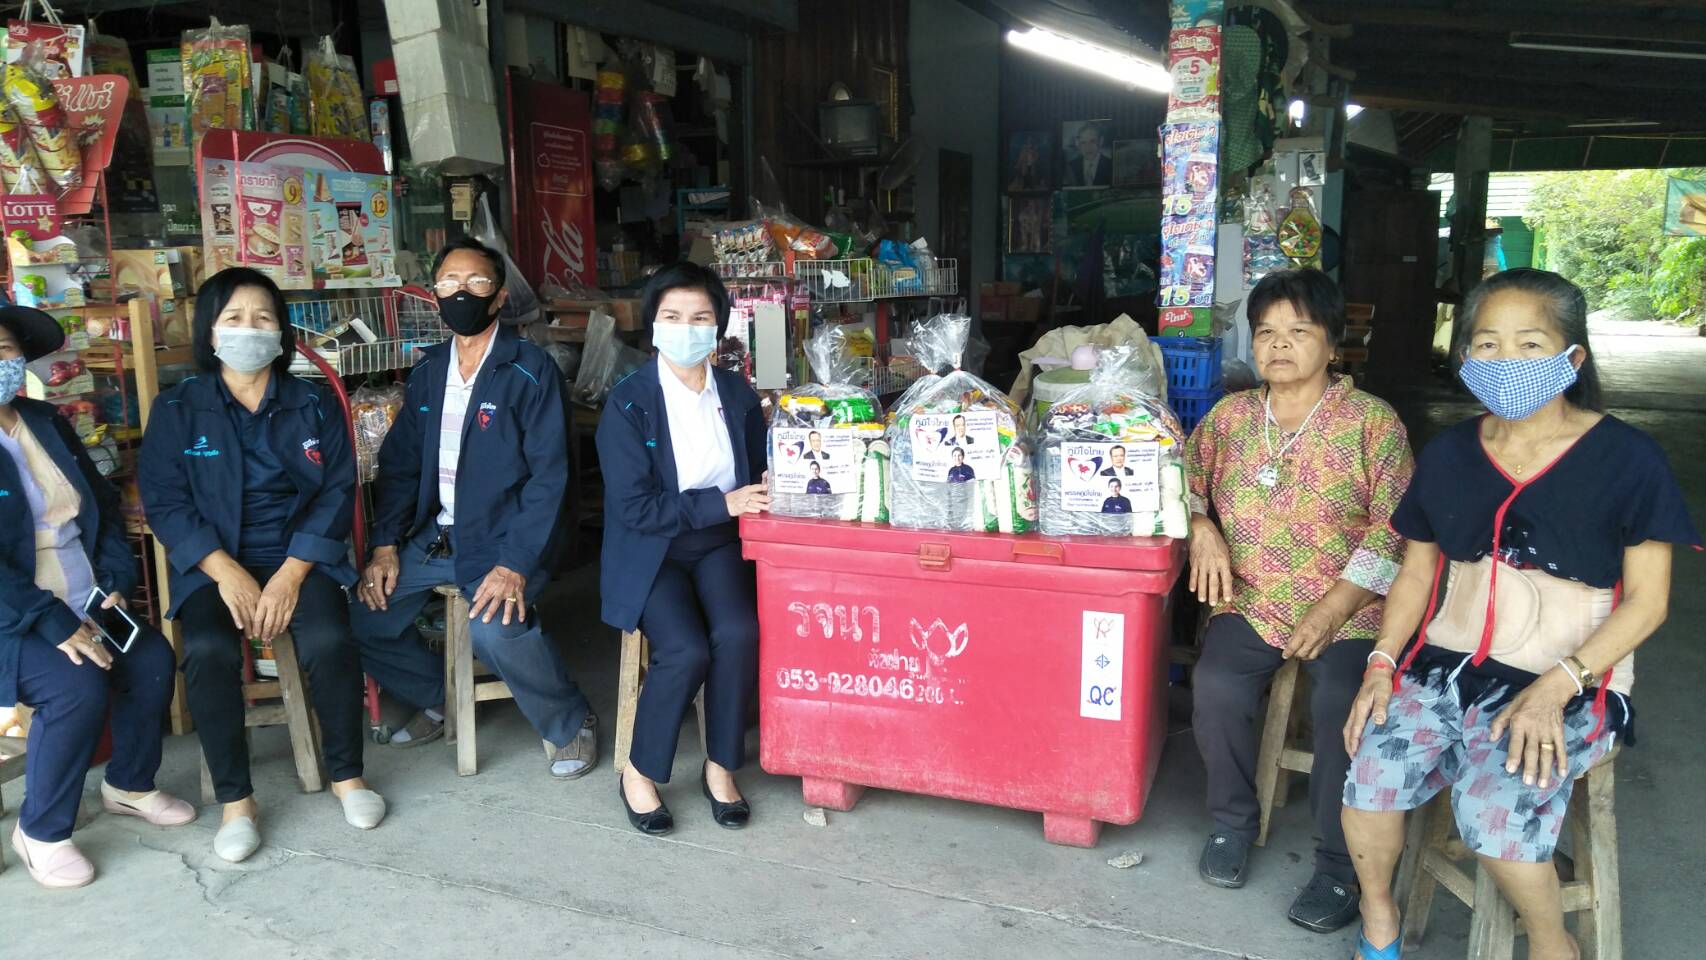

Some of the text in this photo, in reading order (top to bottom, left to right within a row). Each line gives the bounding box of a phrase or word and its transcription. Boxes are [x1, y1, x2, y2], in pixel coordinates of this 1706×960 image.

[4, 204, 57, 217] LOTTE
[374, 200, 386, 214] 12
[1162, 193, 1194, 216] 15
[1160, 285, 1190, 306] 15
[1067, 445, 1104, 457] ภูมิใจไทย
[788, 600, 881, 643] รจนา
[1089, 684, 1115, 706] QC
